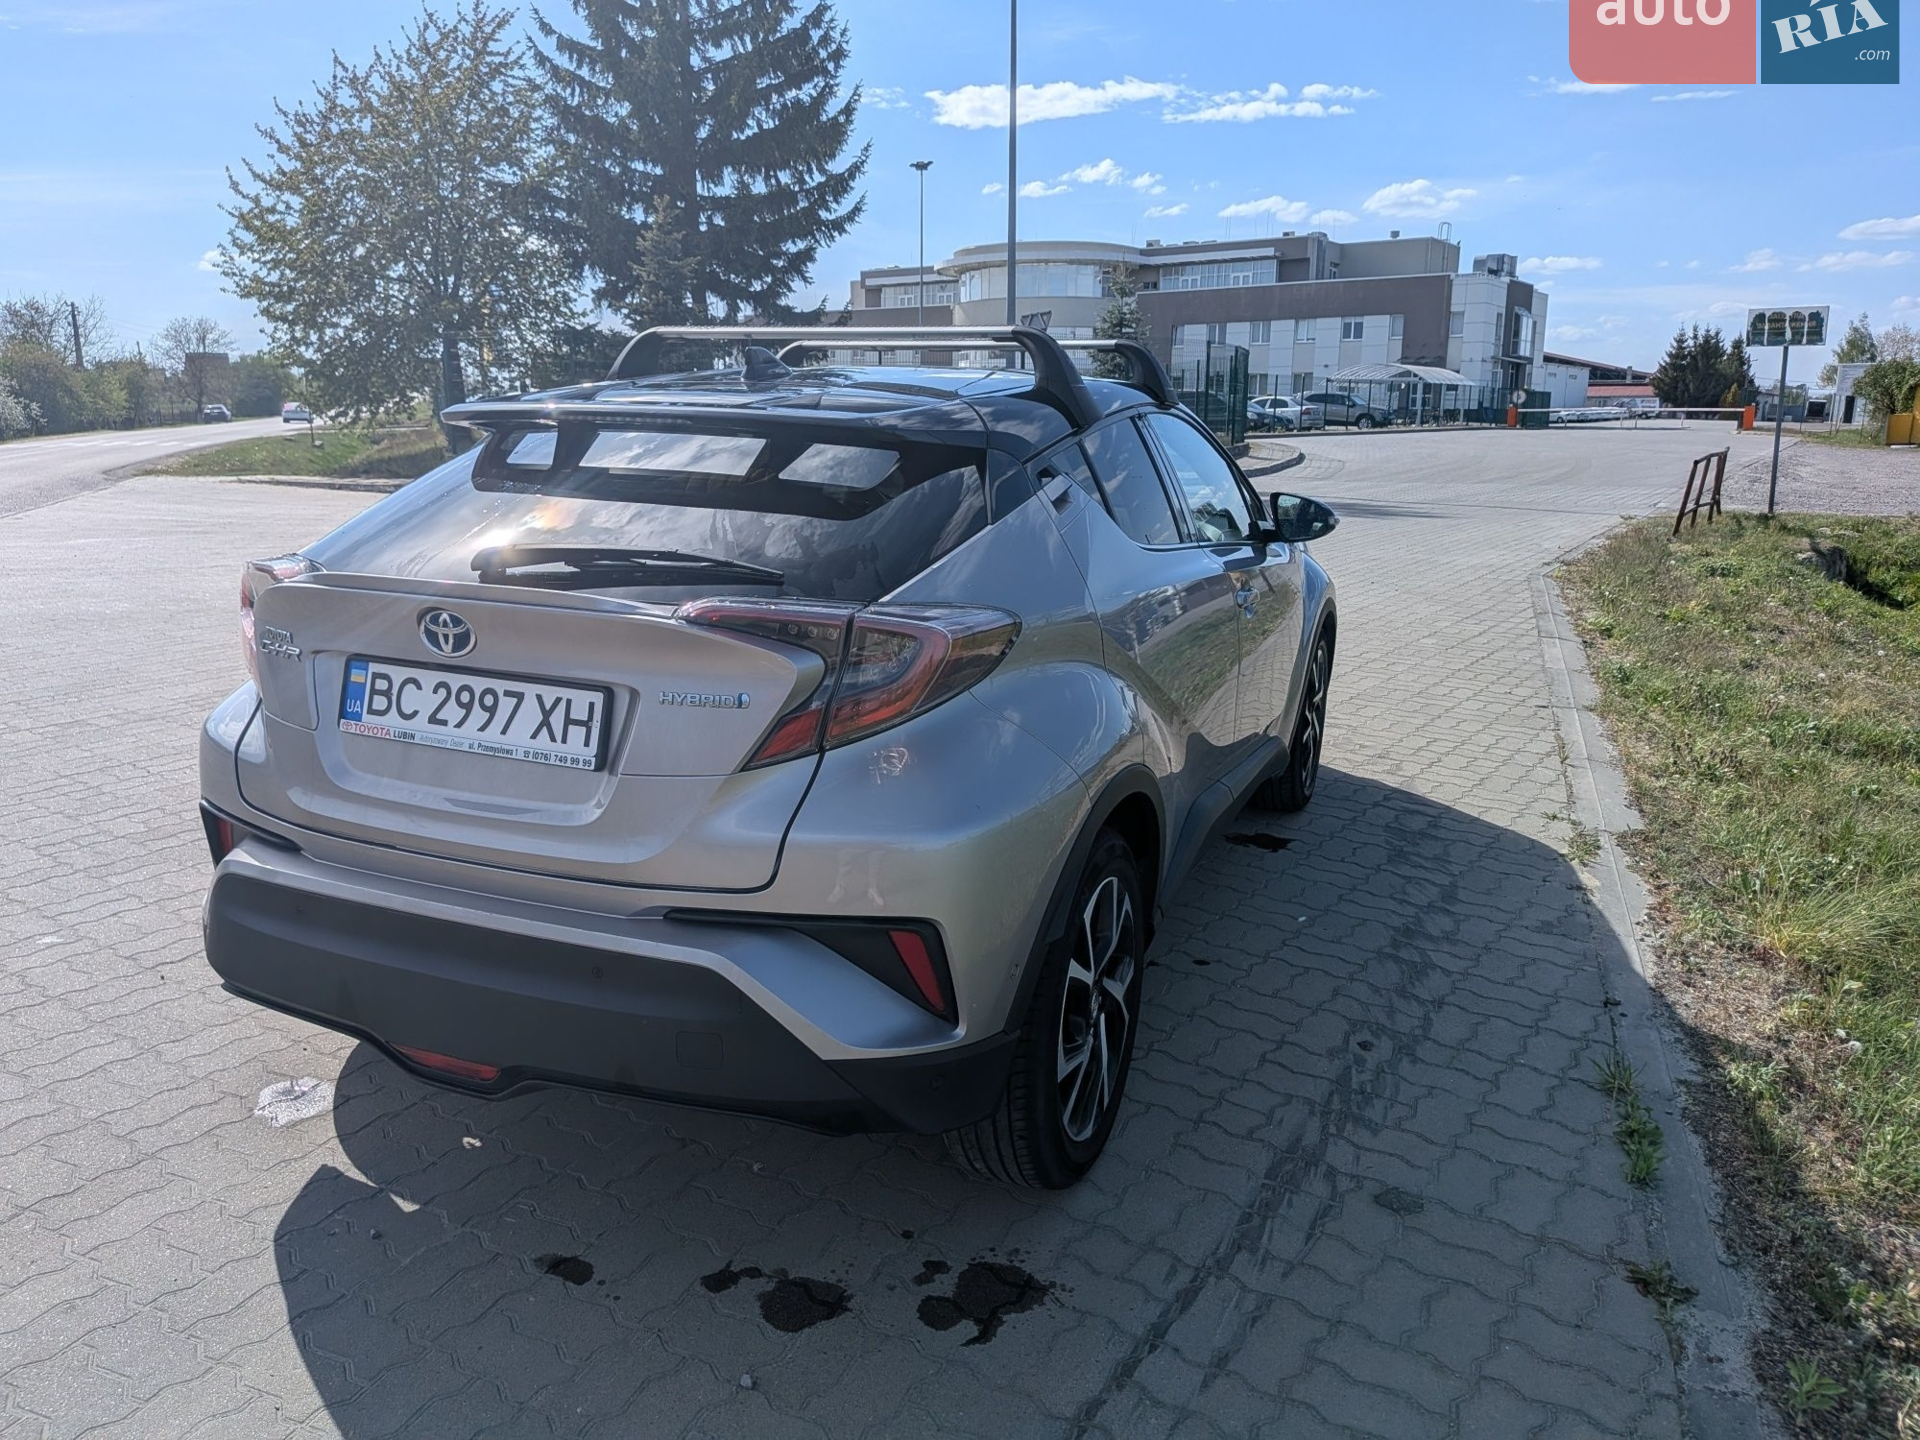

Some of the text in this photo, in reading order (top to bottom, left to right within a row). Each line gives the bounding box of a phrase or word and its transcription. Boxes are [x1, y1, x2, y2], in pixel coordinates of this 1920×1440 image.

[346, 699, 361, 714] UA
[366, 671, 595, 748] BC 2997 XH
[659, 690, 735, 709] HYBRID
[353, 722, 391, 738] TOYOTA
[393, 731, 416, 742] LUBIN
[532, 750, 552, 763] (076)
[554, 754, 568, 765] 749
[570, 757, 580, 766] 99
[582, 758, 592, 768] 99
